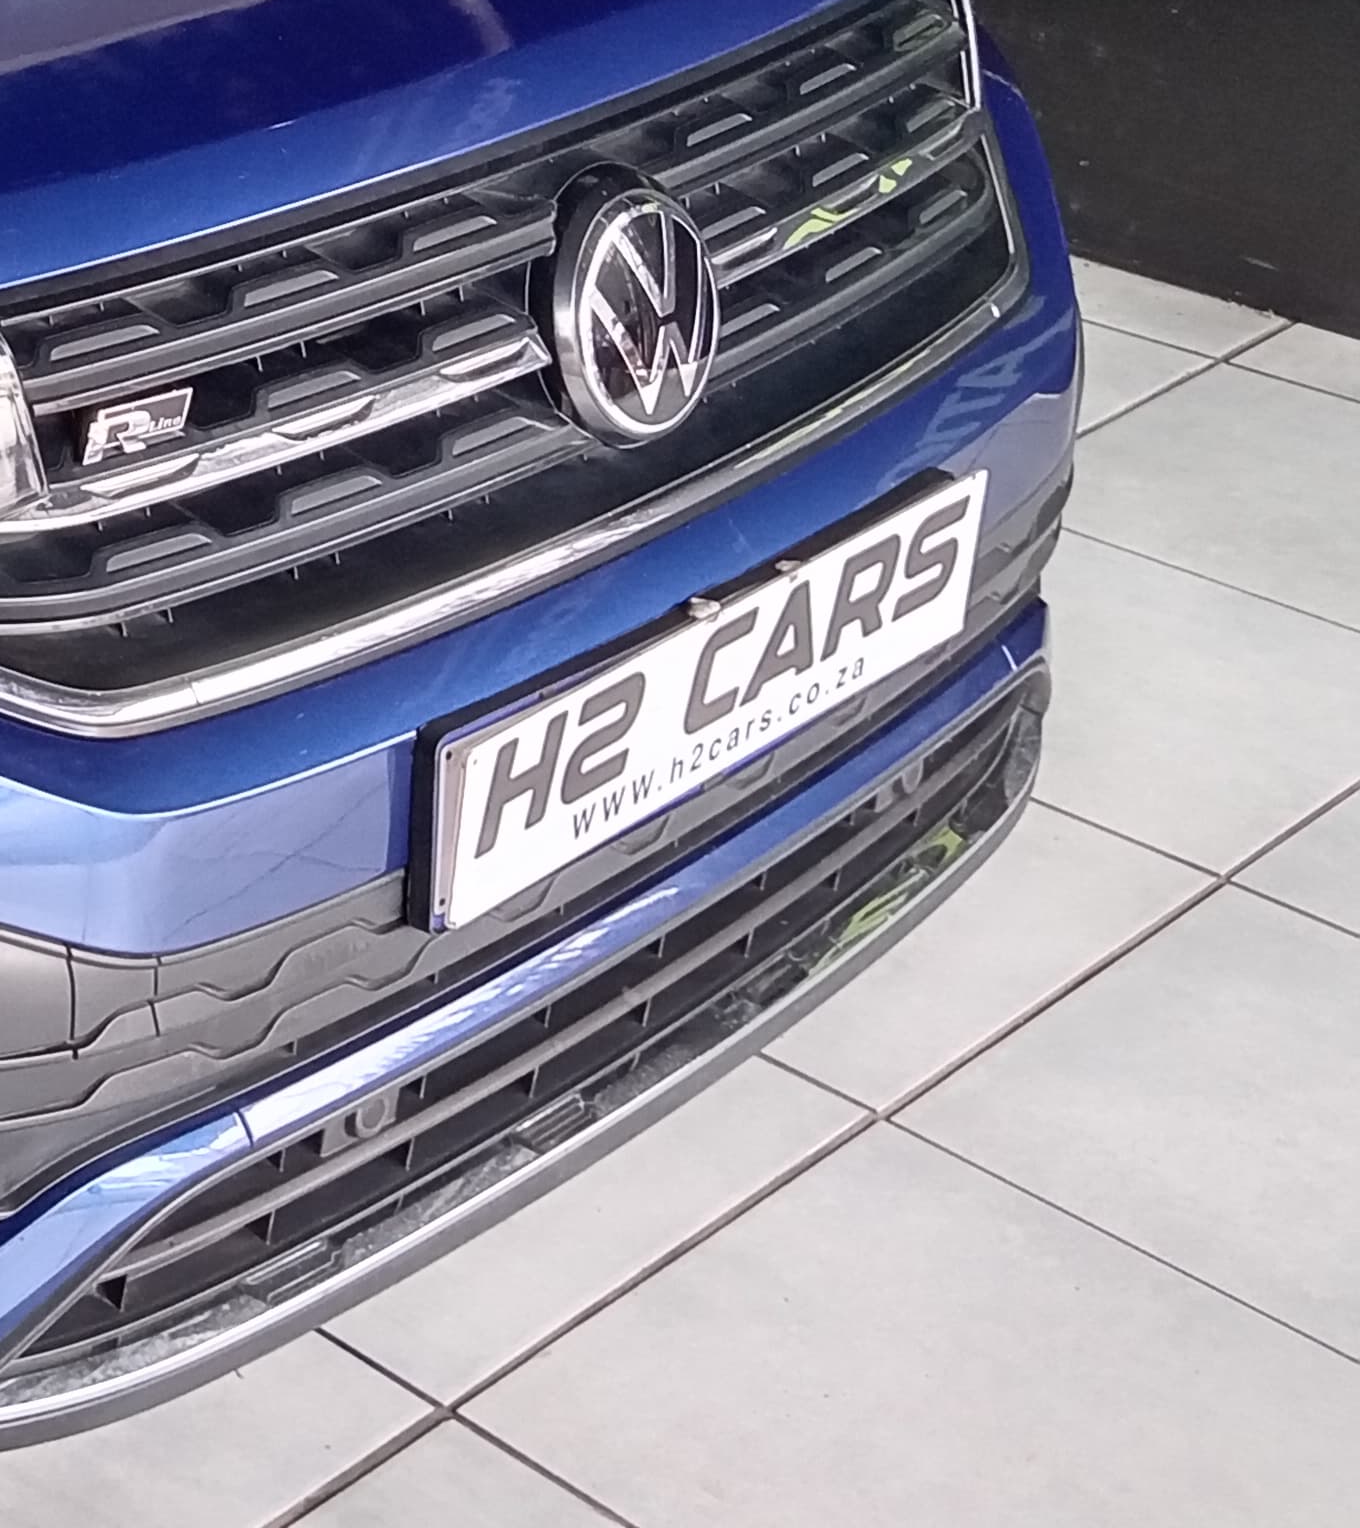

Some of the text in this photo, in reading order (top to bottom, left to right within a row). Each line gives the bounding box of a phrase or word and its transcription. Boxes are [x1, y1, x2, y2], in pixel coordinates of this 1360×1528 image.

[474, 494, 971, 860] H2 CARS
[572, 657, 866, 840] www.h2cars.co.za
